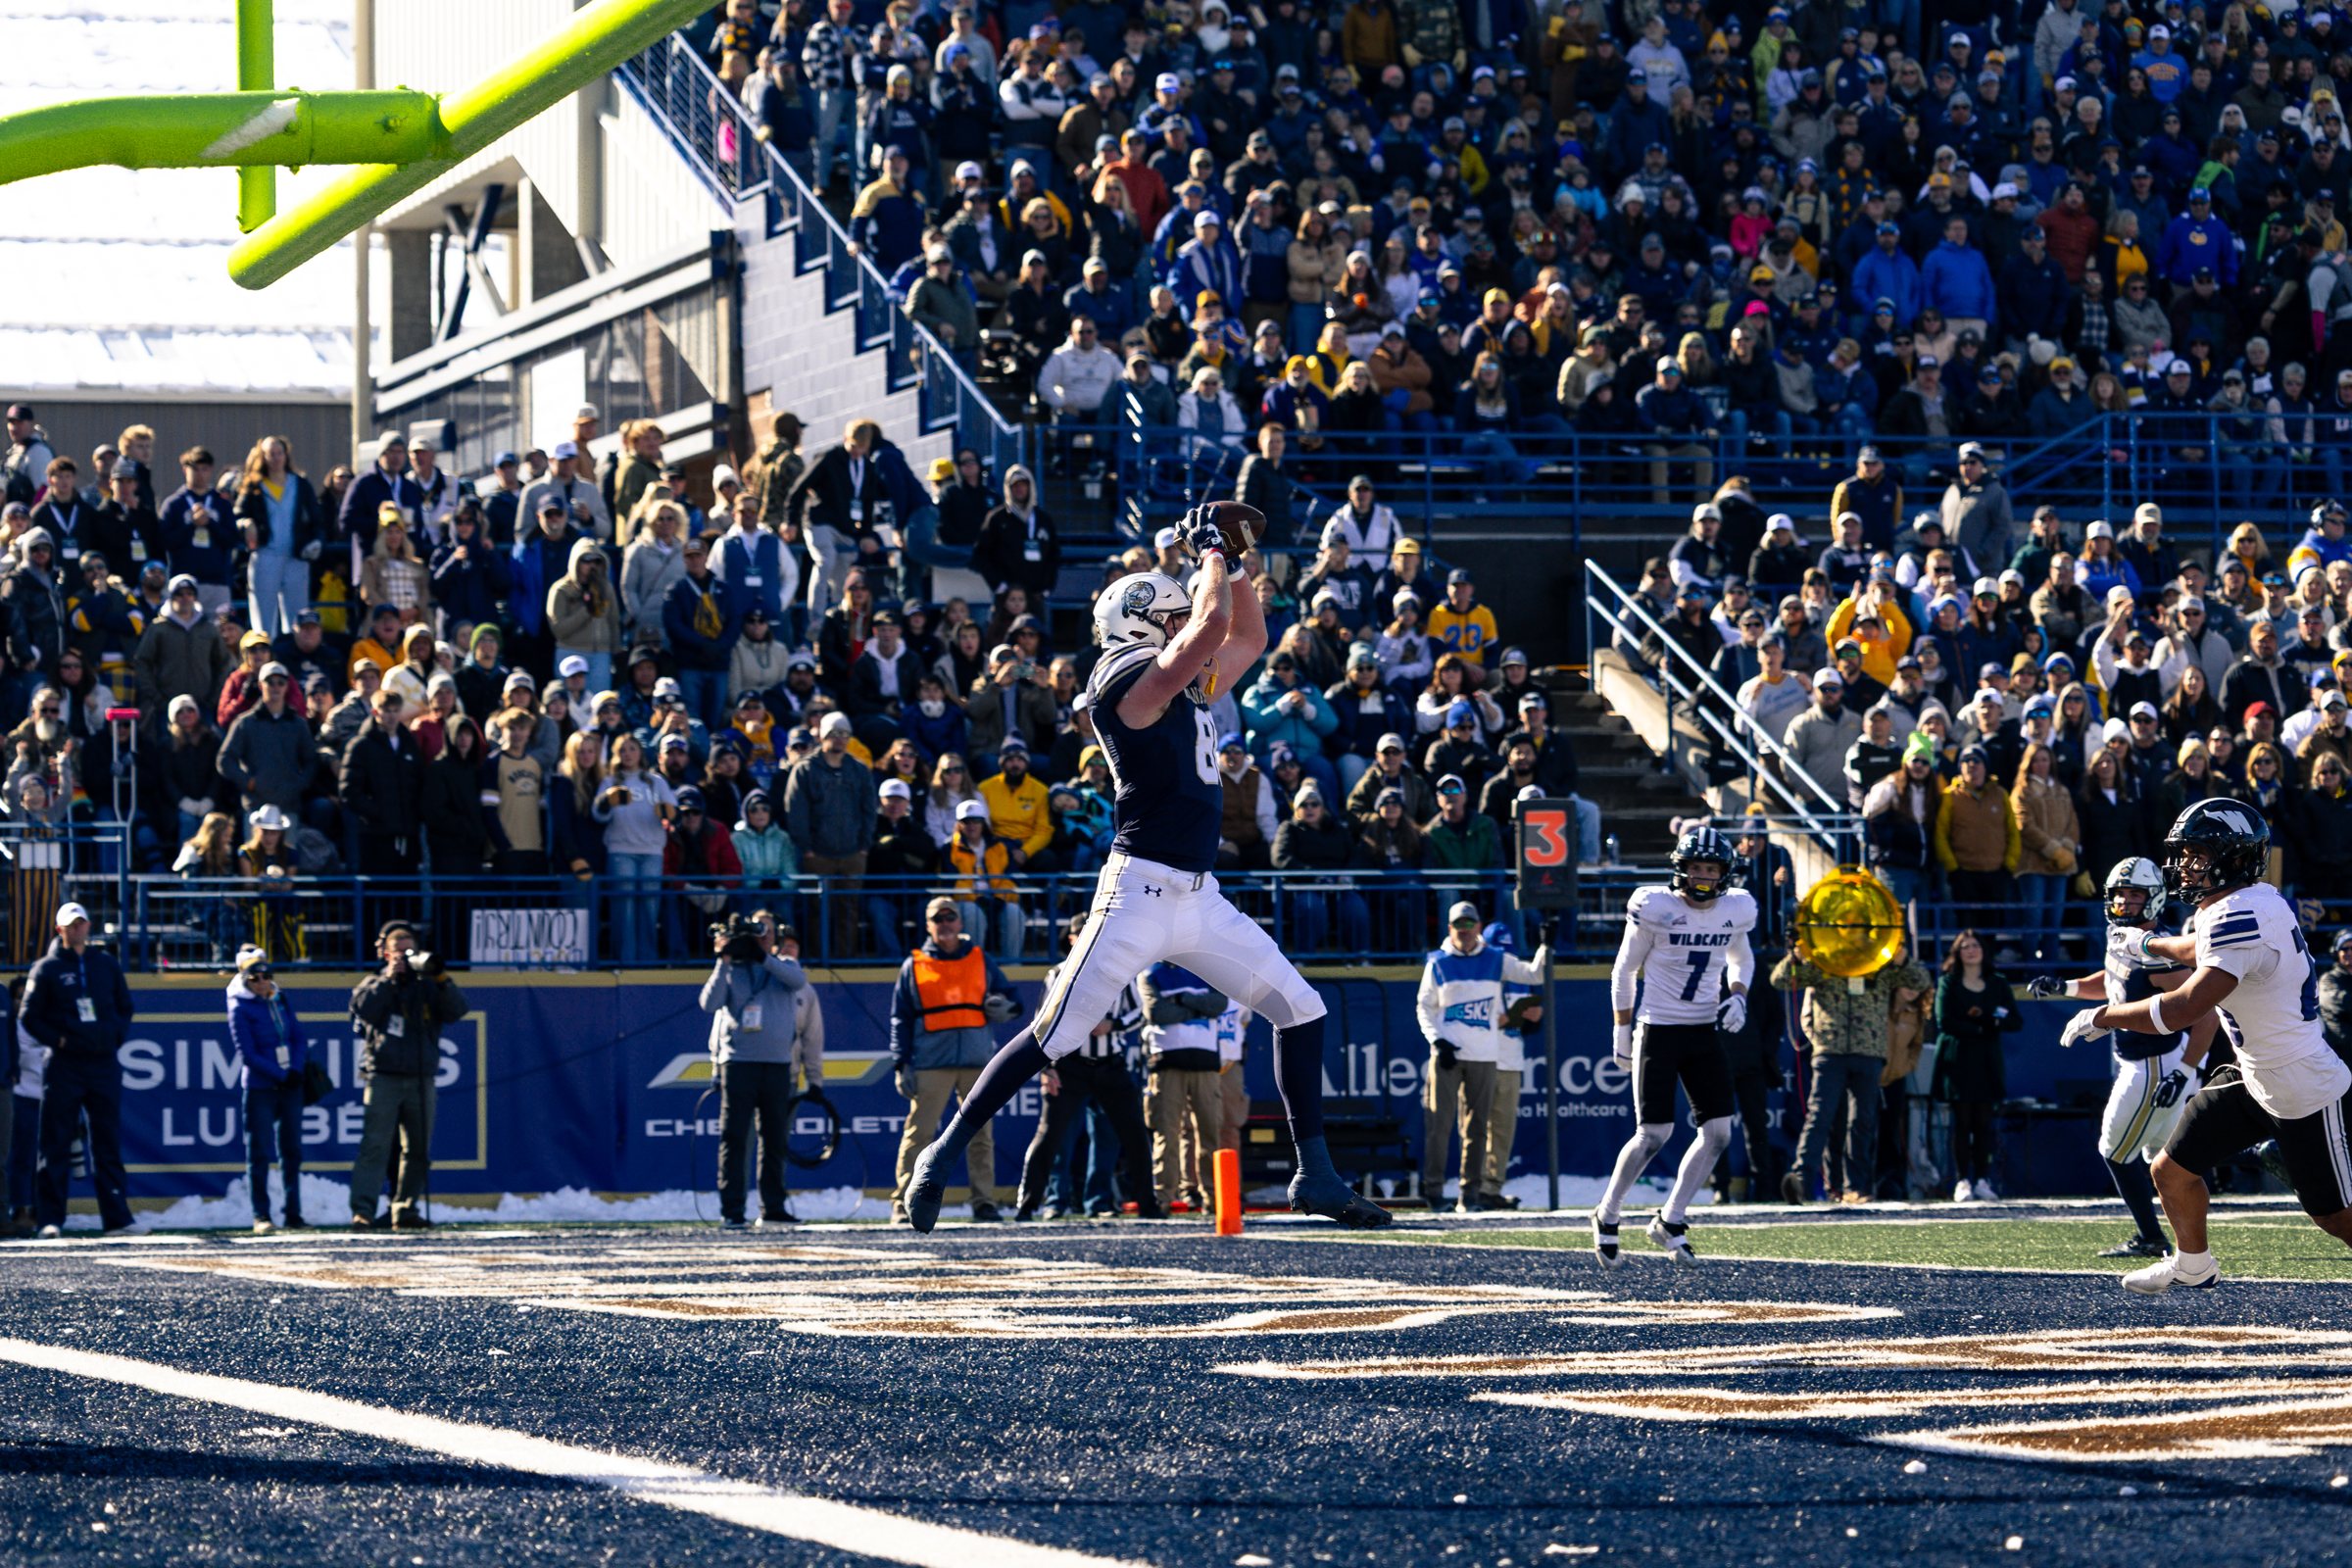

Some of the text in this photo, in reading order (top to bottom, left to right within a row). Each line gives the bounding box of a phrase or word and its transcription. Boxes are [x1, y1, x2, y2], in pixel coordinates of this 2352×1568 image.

[1446, 624, 1482, 653] 23
[1524, 809, 1568, 867] 3
[1668, 933, 1732, 947] WILDCATS
[1680, 950, 1712, 1003] 7
[1536, 1101, 1629, 1118] Halthcare
